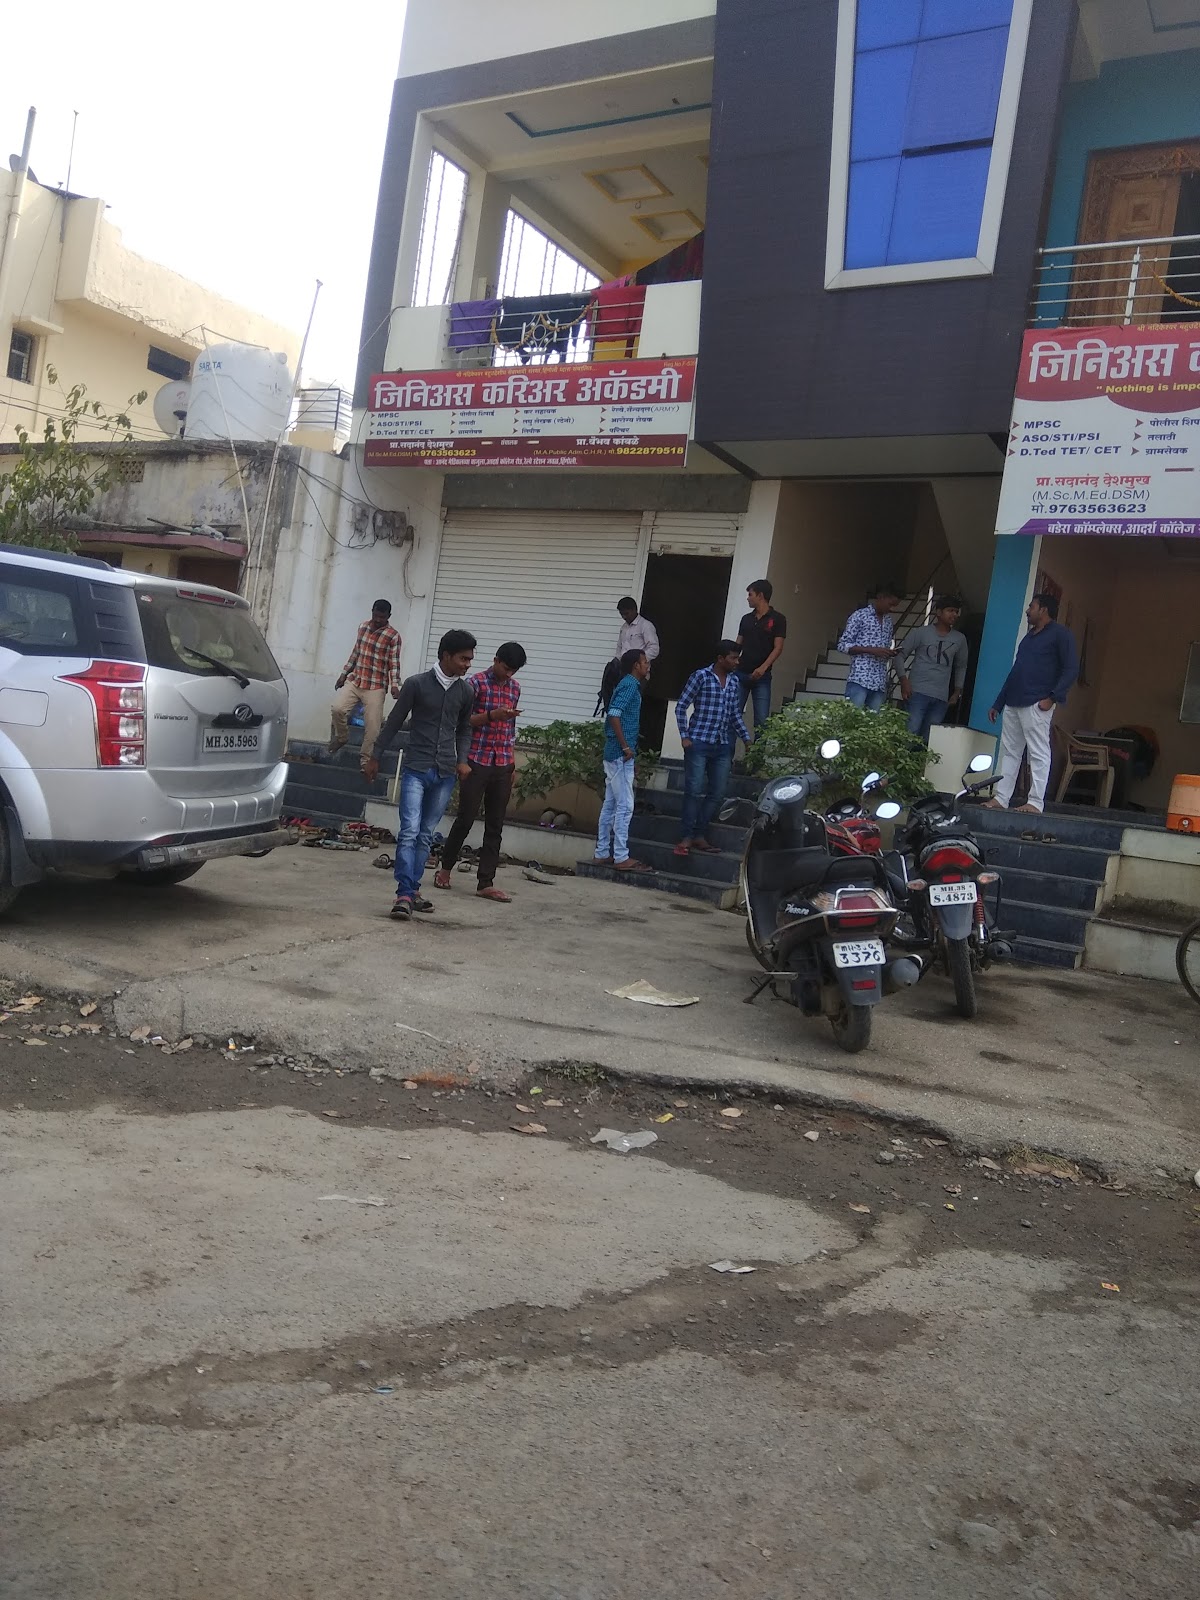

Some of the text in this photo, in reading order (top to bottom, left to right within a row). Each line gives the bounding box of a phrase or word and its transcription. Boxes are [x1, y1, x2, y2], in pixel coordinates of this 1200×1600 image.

[199, 361, 222, 370] SARTA
[1028, 339, 1179, 383] जिनिअस
[374, 367, 682, 408] जिनिअस करिअर अकॅडमी
[1105, 384, 1154, 394] Nothing
[1158, 383, 1169, 391] is
[1024, 420, 1061, 429] MPSC
[1149, 418, 1179, 427] पोलीस
[1022, 432, 1100, 443] ASO/STI/PSI
[1148, 432, 1176, 441] तलाठी
[1020, 448, 1056, 456] D.Ted
[1094, 446, 1121, 454] CET
[1145, 446, 1188, 455] ग्रामसेवक
[1036, 473, 1151, 489] प्रा.सदानंद देशमुख
[1032, 489, 1150, 502] (M.Sc.M.Ed.DSM)
[1160, 520, 1196, 534] कॉलेज
[205, 735, 258, 748] MH.38.5963
[934, 892, 974, 903] S.4873
[840, 950, 881, 964] 3376
